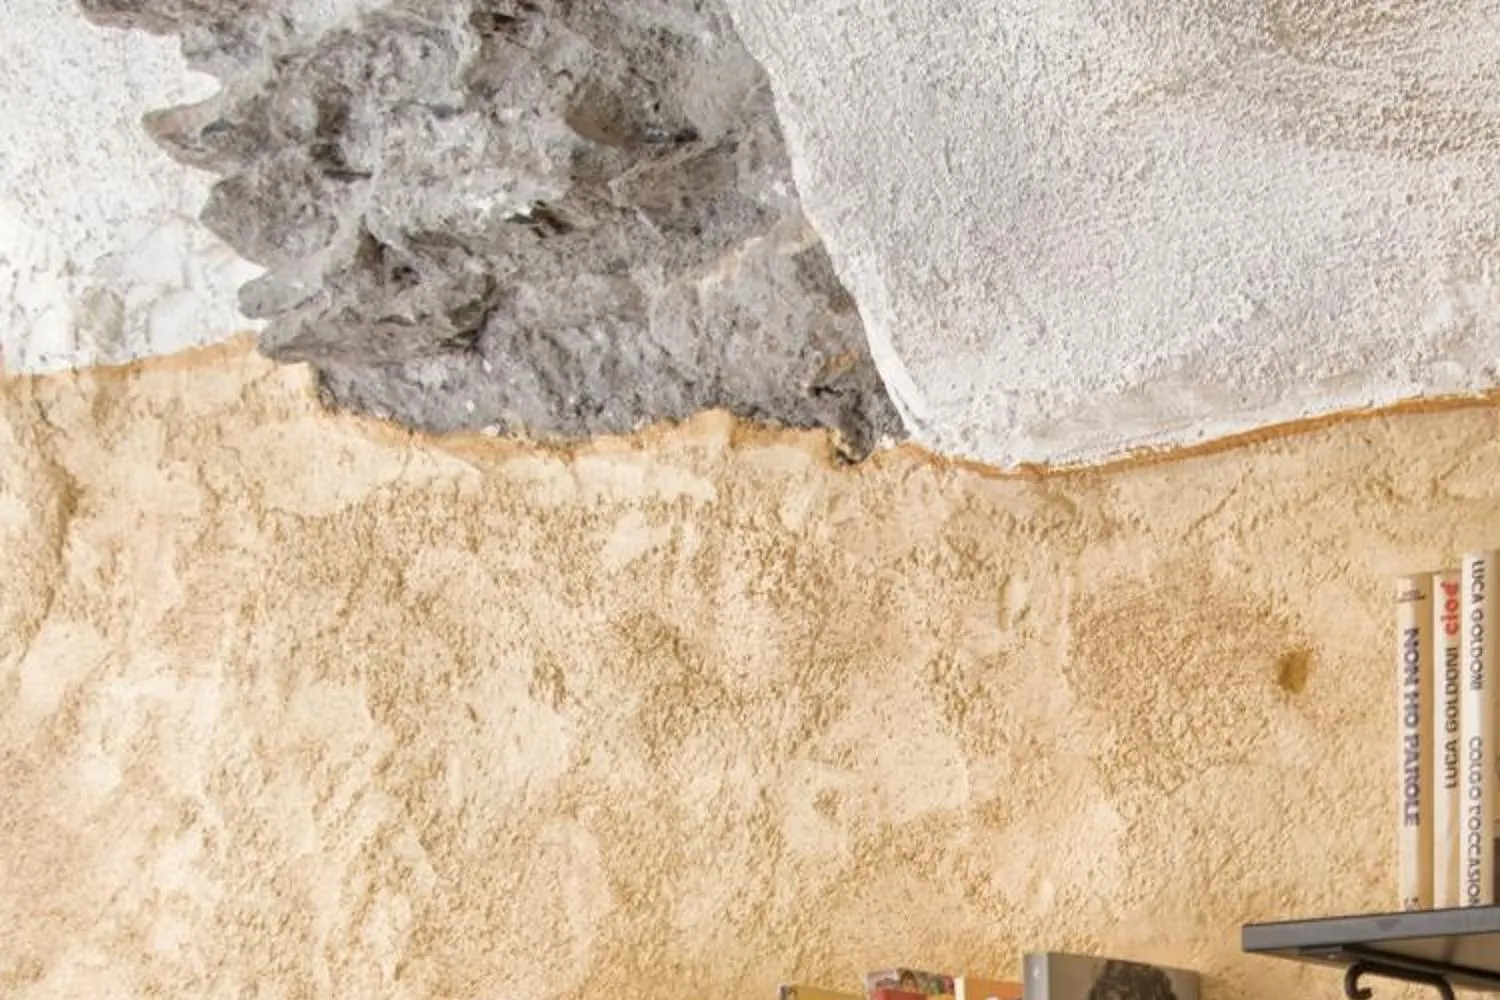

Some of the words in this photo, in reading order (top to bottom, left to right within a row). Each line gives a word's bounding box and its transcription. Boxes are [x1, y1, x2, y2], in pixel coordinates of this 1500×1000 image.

[1471, 560, 1485, 604] LUCA
[1403, 628, 1420, 685] NON
[1469, 608, 1484, 691] GOLDONI
[1404, 691, 1420, 727] HO
[1444, 647, 1459, 733] GOLDONI
[1404, 734, 1421, 827] PAROLE
[1444, 740, 1459, 789] LUCA
[1469, 736, 1483, 800] COLGO
